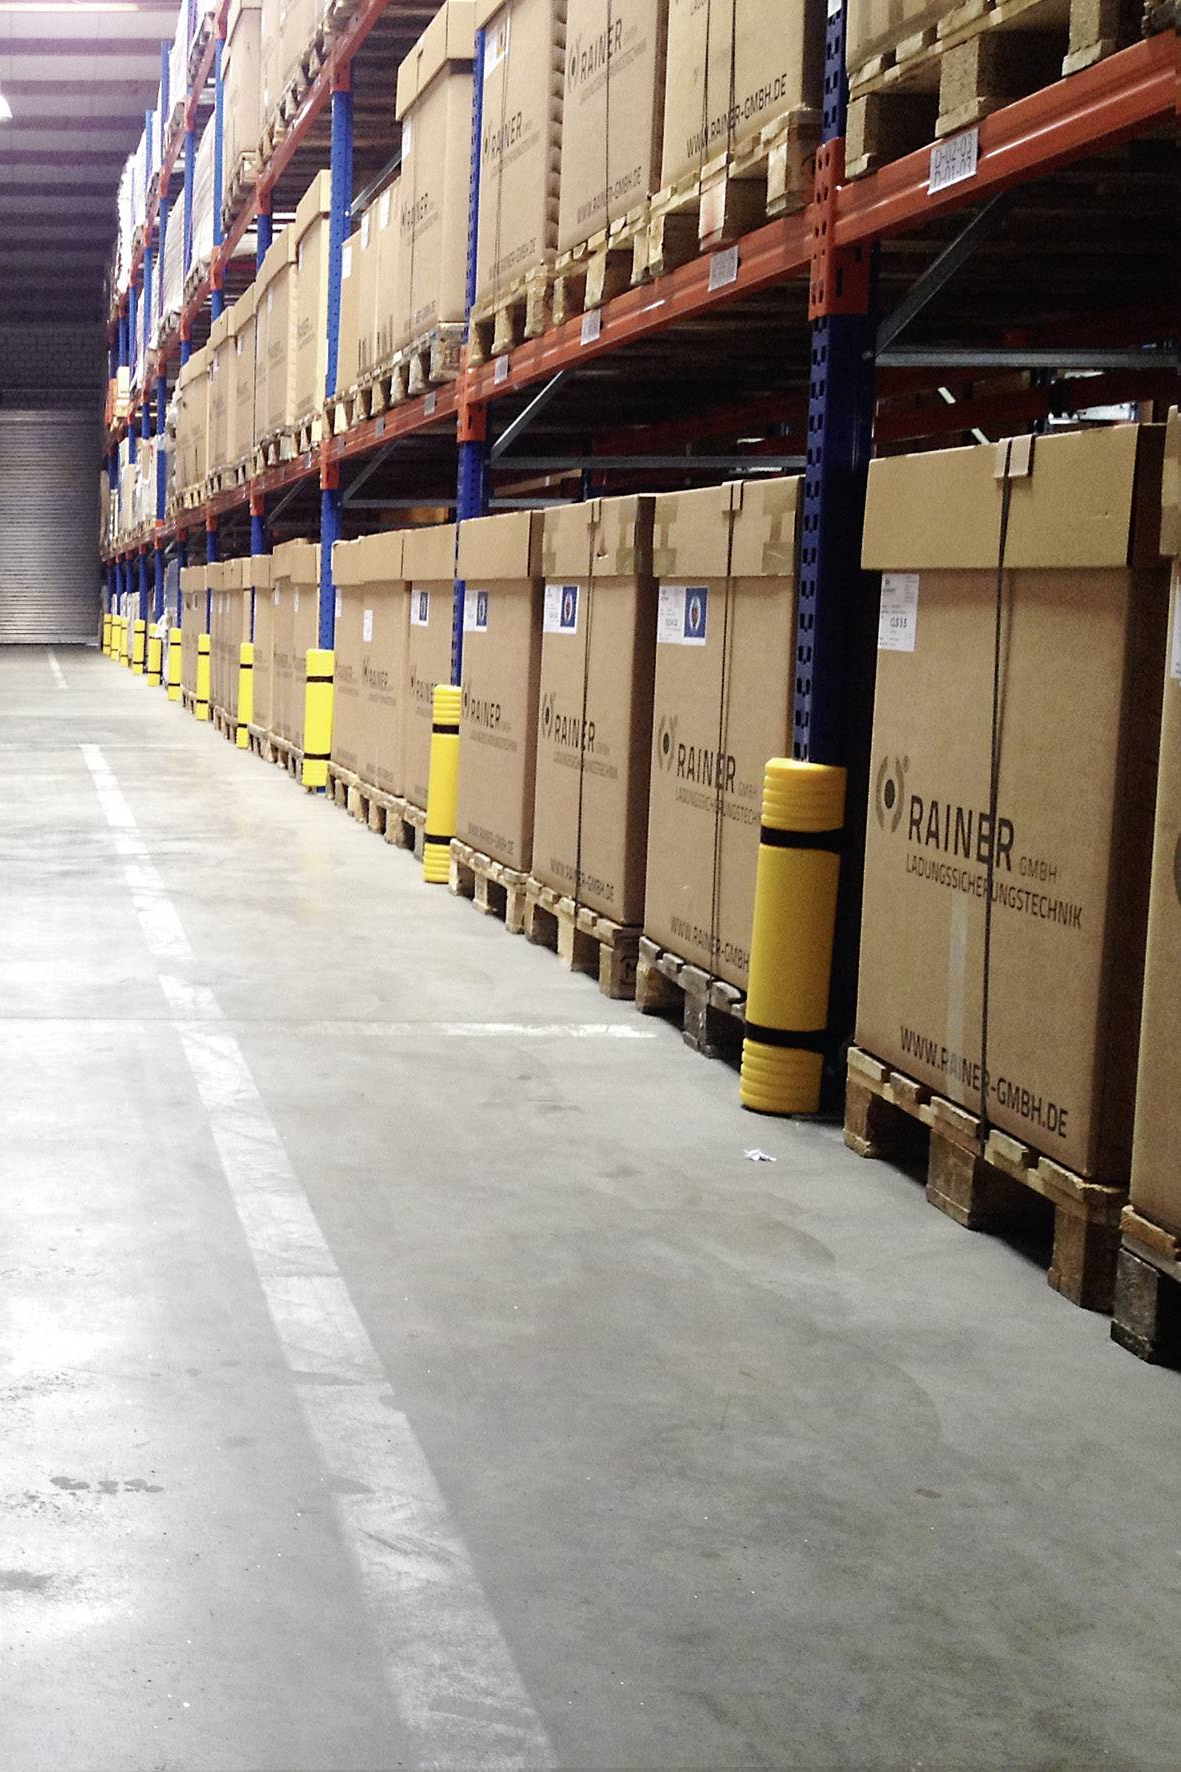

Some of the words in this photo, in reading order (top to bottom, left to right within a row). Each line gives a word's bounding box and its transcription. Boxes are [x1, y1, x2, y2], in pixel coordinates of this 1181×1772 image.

[676, 743, 736, 794] RAINER
[908, 794, 1015, 872] RAINER
[1019, 856, 1058, 884] GMBH
